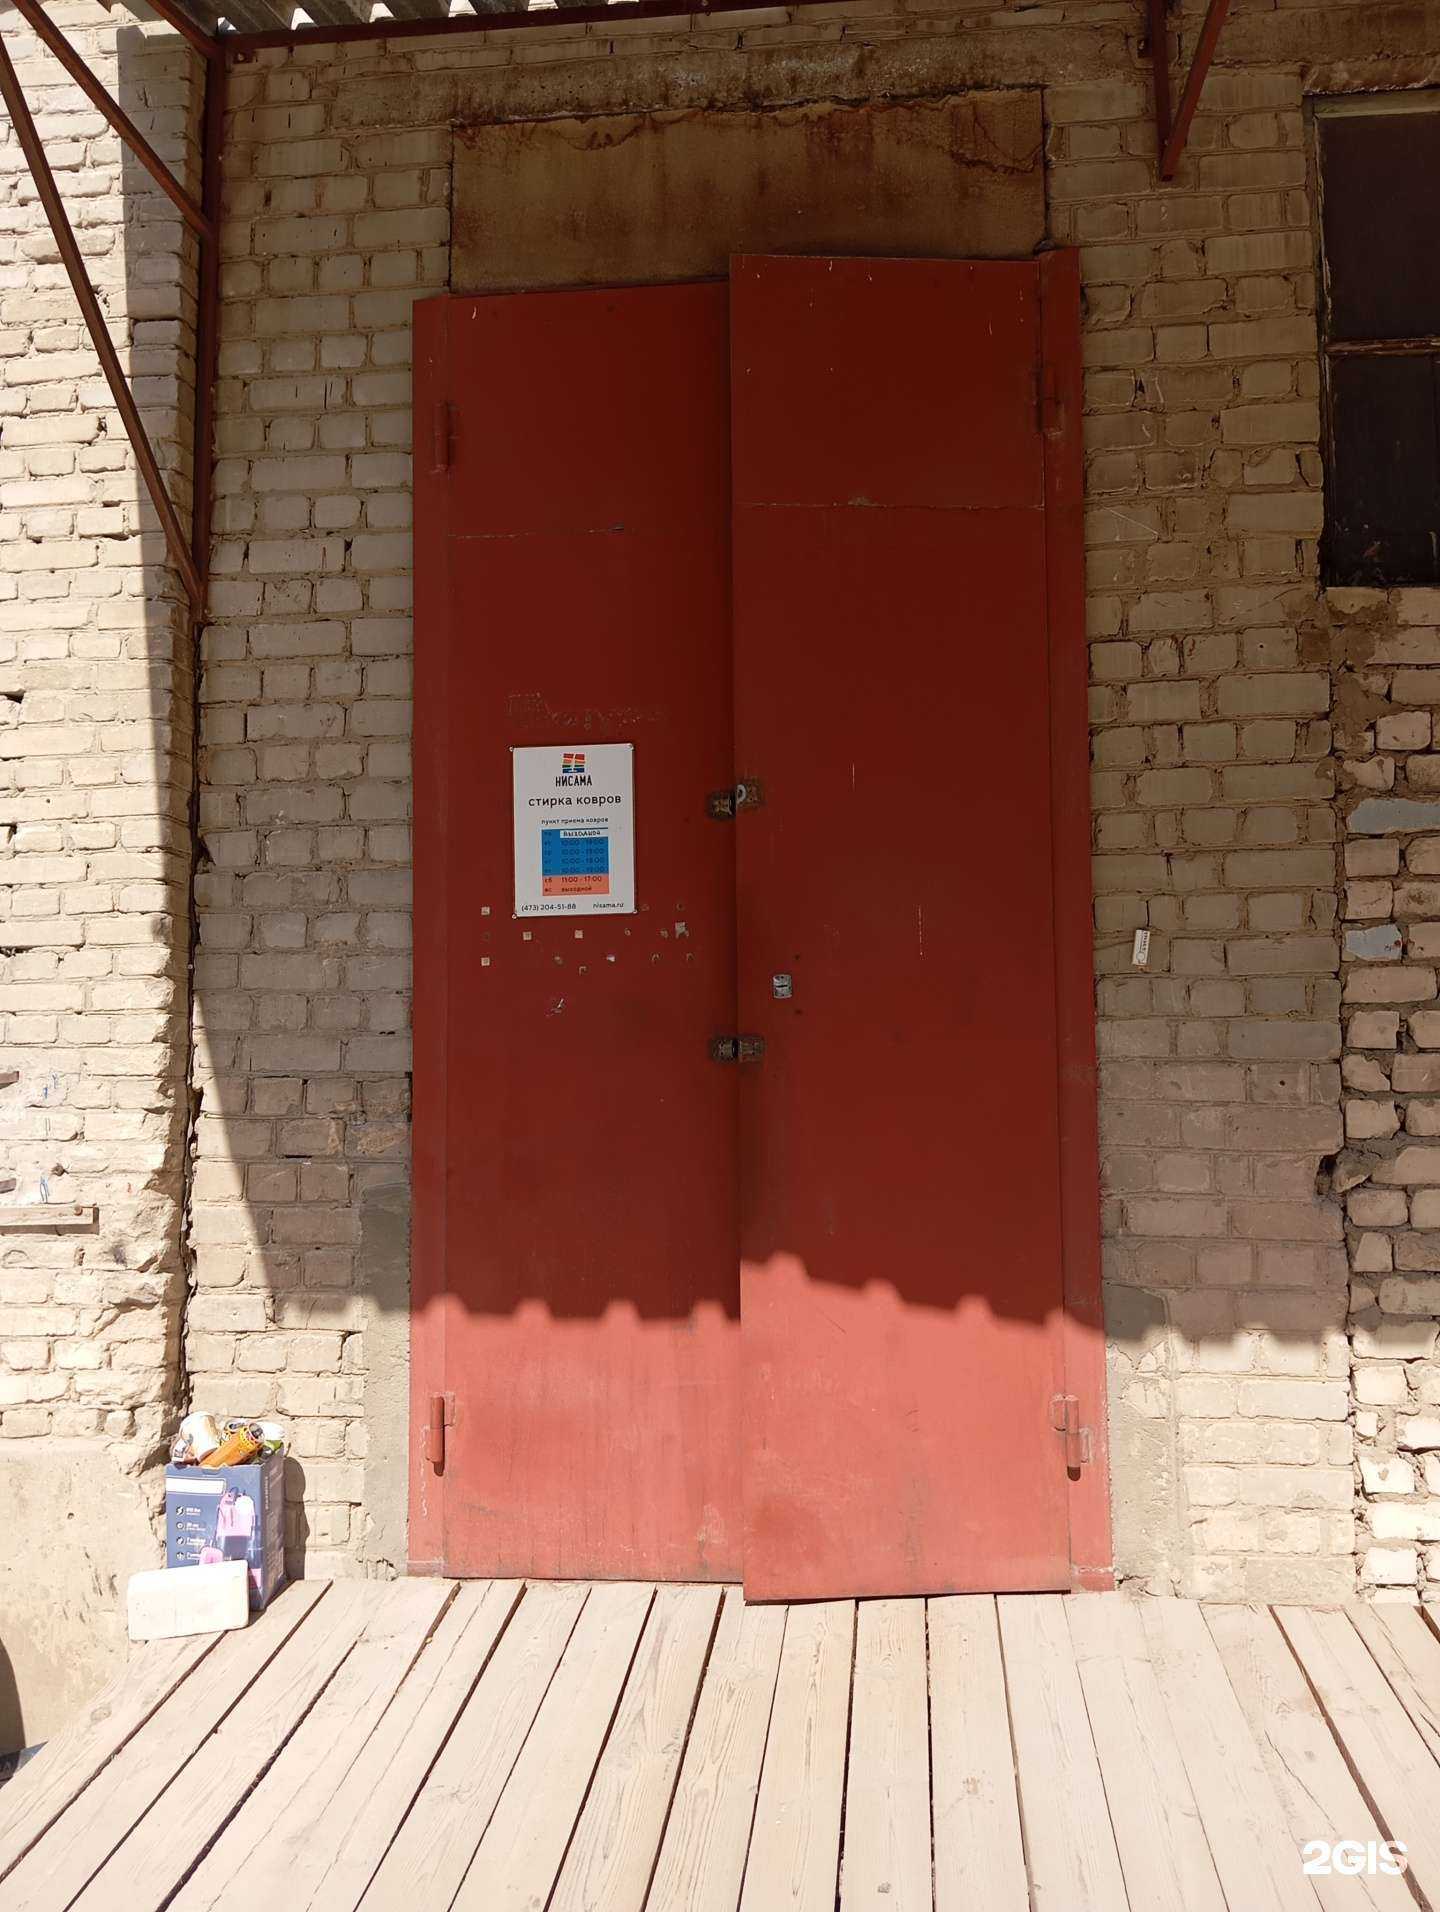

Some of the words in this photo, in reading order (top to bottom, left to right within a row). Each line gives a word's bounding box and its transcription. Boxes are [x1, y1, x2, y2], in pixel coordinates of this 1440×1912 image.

[555, 775, 593, 787] НИСАМА
[528, 796, 572, 809] стирка
[576, 794, 621, 807] ковров
[521, 903, 539, 911] (473)
